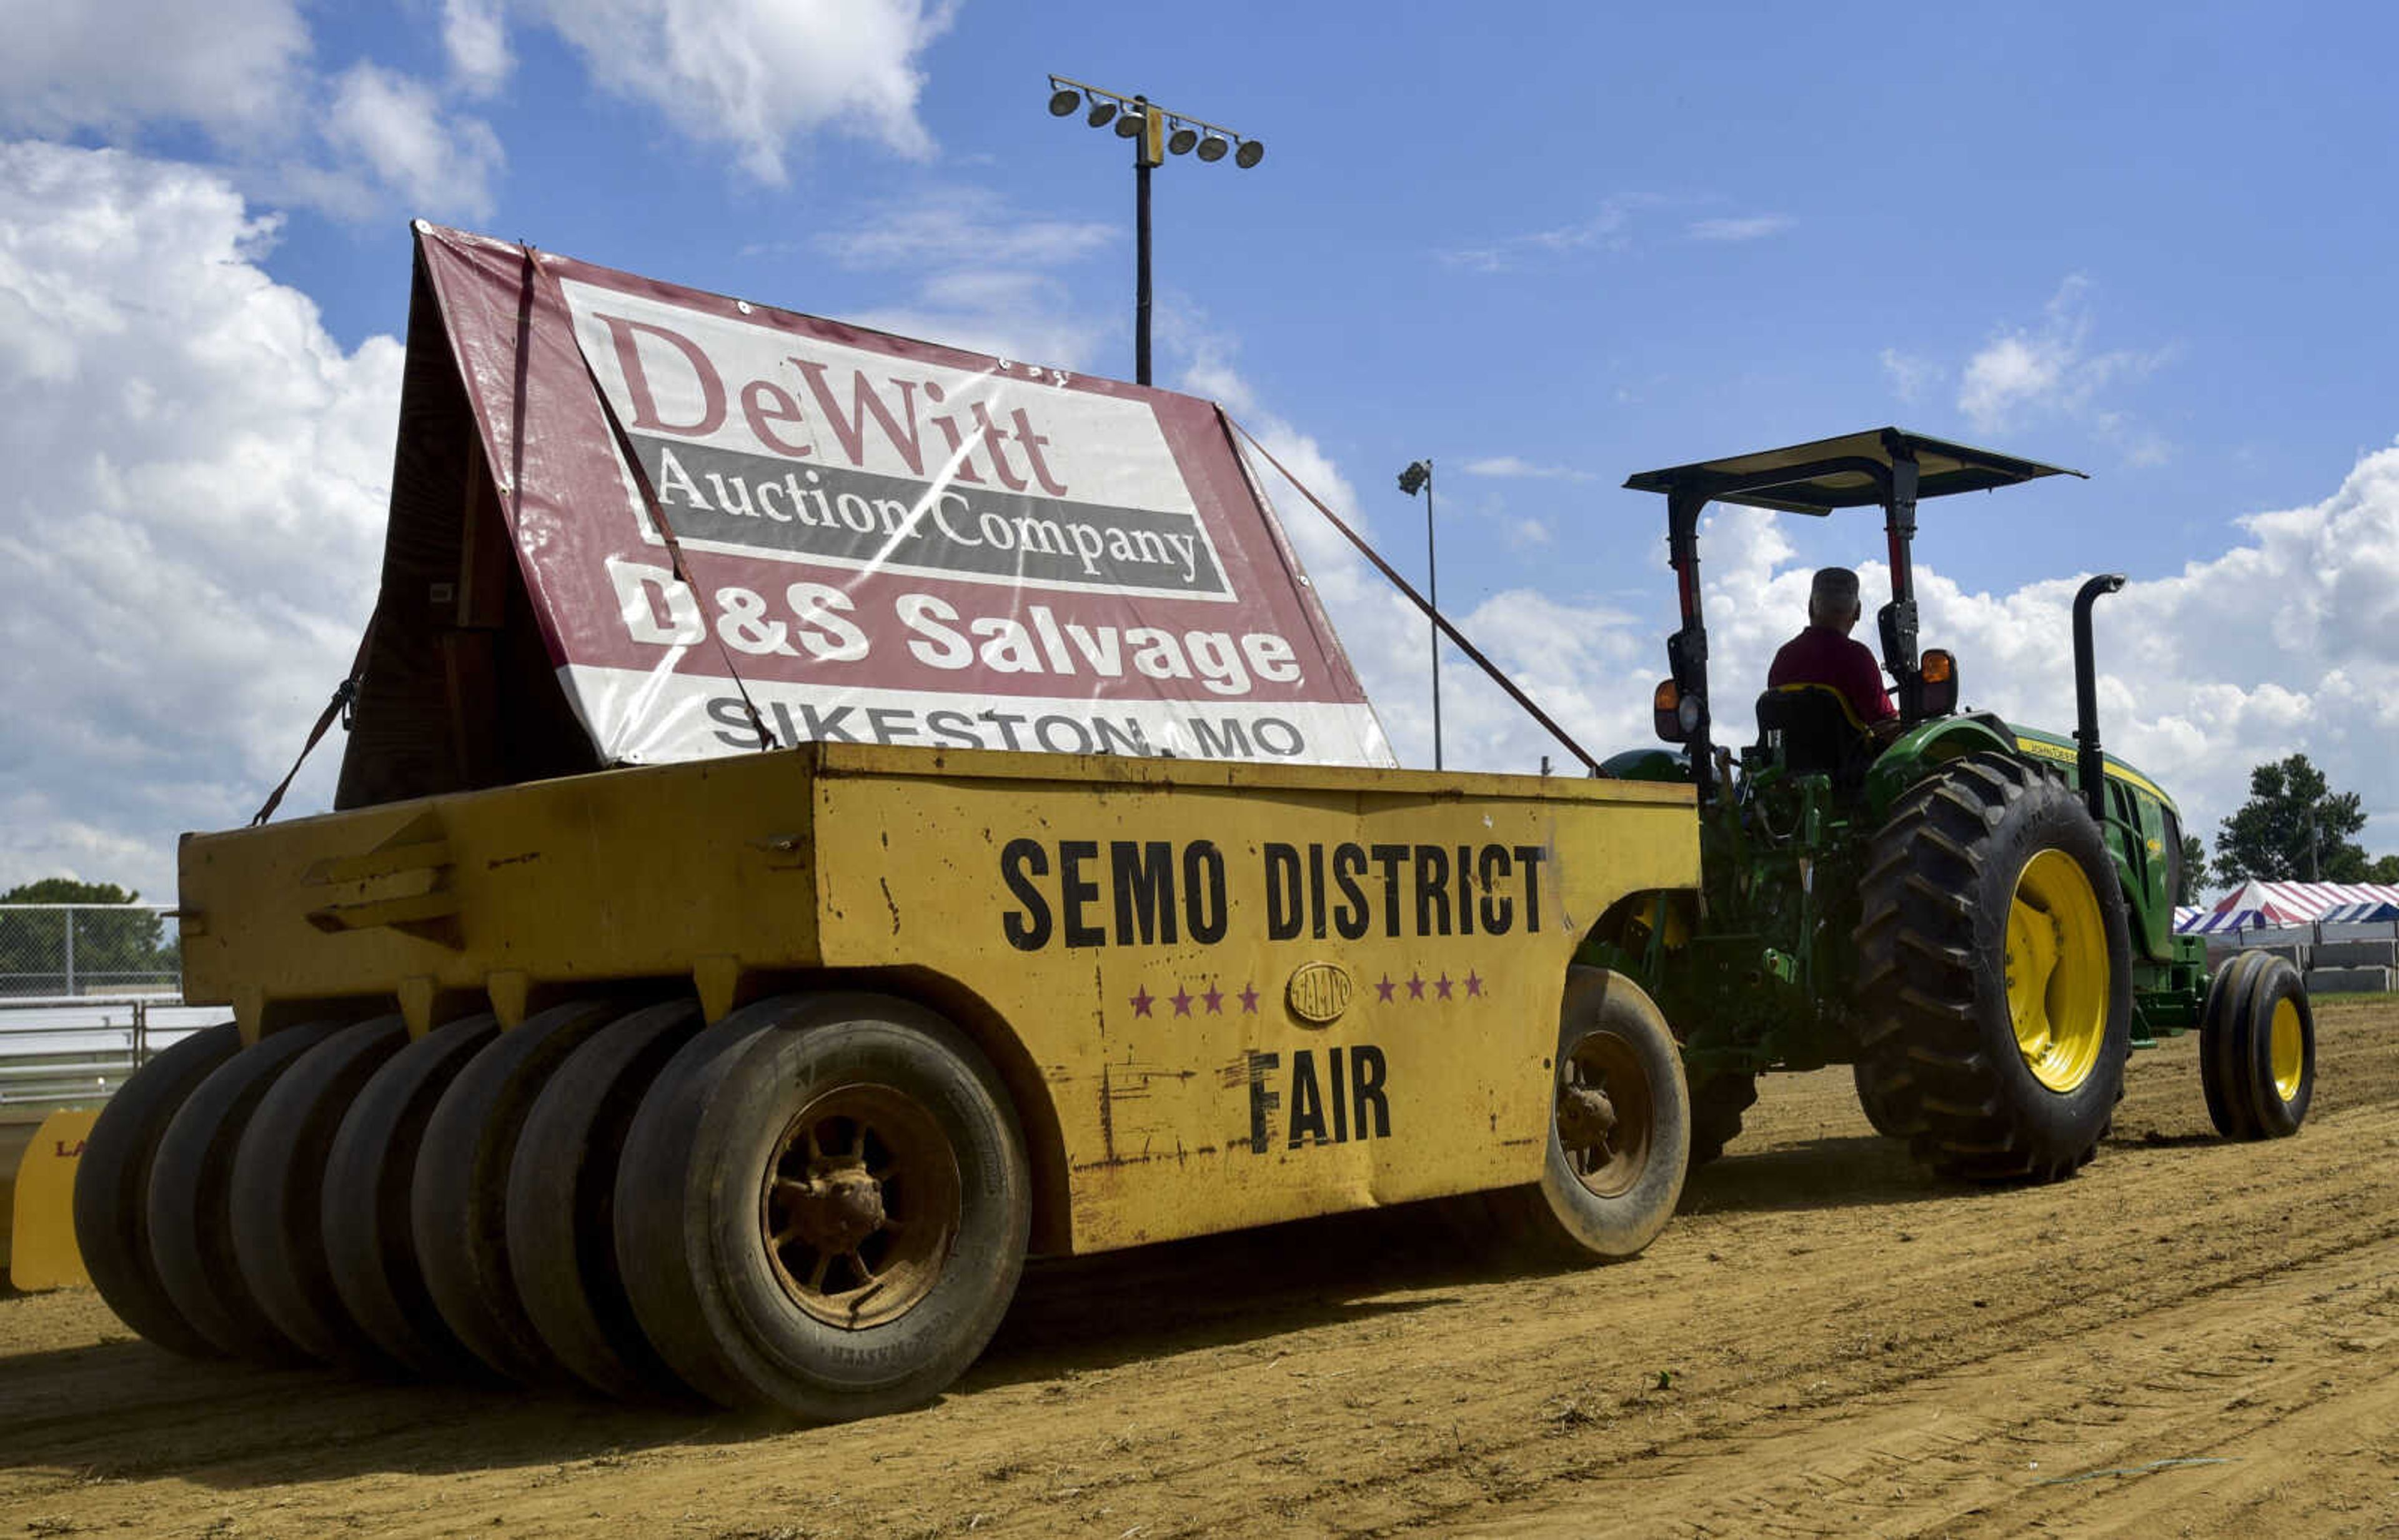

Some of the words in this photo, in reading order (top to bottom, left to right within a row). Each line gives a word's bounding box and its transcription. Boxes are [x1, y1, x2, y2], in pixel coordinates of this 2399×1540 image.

[592, 312, 1068, 496] DeWitt
[657, 447, 923, 539] Auction
[931, 491, 1198, 583] Company
[606, 557, 870, 662] D&S
[895, 594, 1302, 695] Salvage
[1188, 718, 1304, 757] MO
[1001, 838, 1227, 951] SEMO
[1264, 840, 1547, 941] DISTRICT
[1250, 1045, 1391, 1153] FAIR
